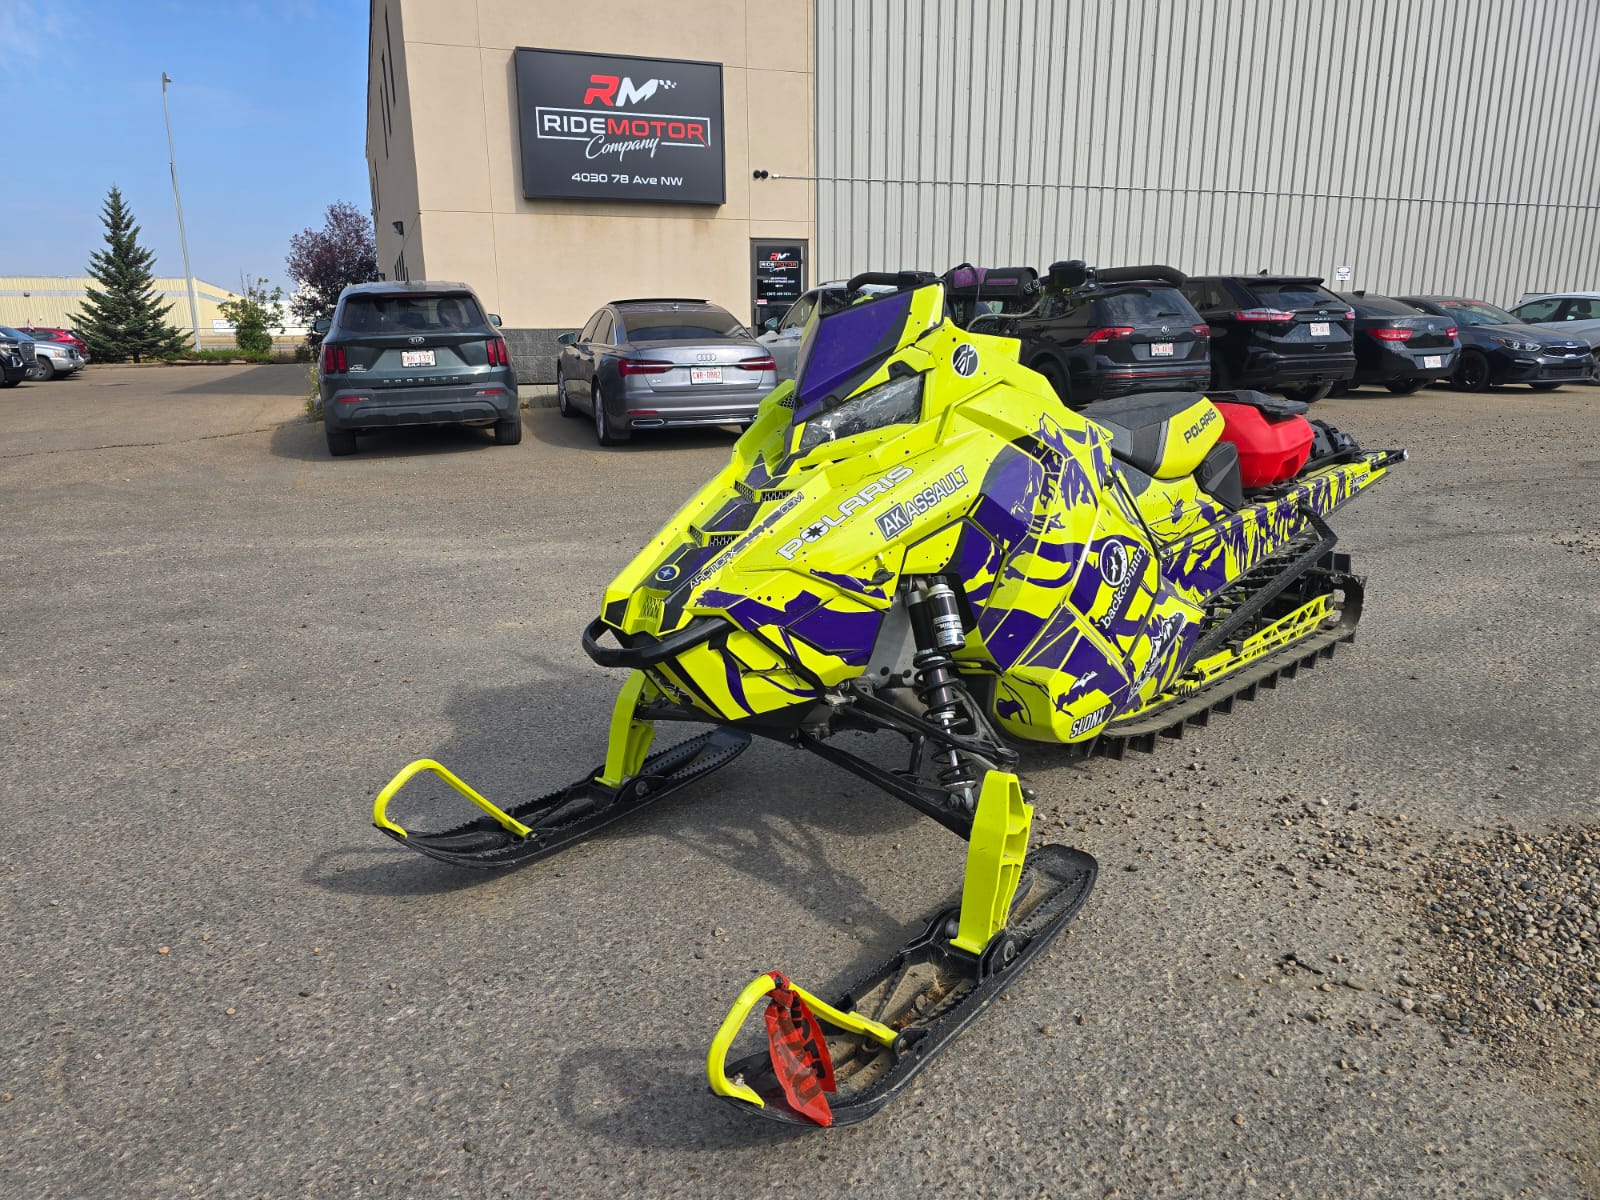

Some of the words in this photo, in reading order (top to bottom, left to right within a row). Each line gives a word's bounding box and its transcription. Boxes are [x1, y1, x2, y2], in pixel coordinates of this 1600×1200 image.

[583, 74, 659, 107] RM
[585, 134, 659, 162] Company
[571, 172, 608, 183] 4030
[611, 174, 629, 184] 78
[632, 175, 658, 185] Ave
[661, 177, 683, 186] NW
[1183, 407, 1216, 444] POLARIS
[776, 465, 914, 560] POLARIS
[881, 505, 907, 538] AK
[906, 465, 969, 520] ASSAULT
[1100, 544, 1147, 629] backcountry
